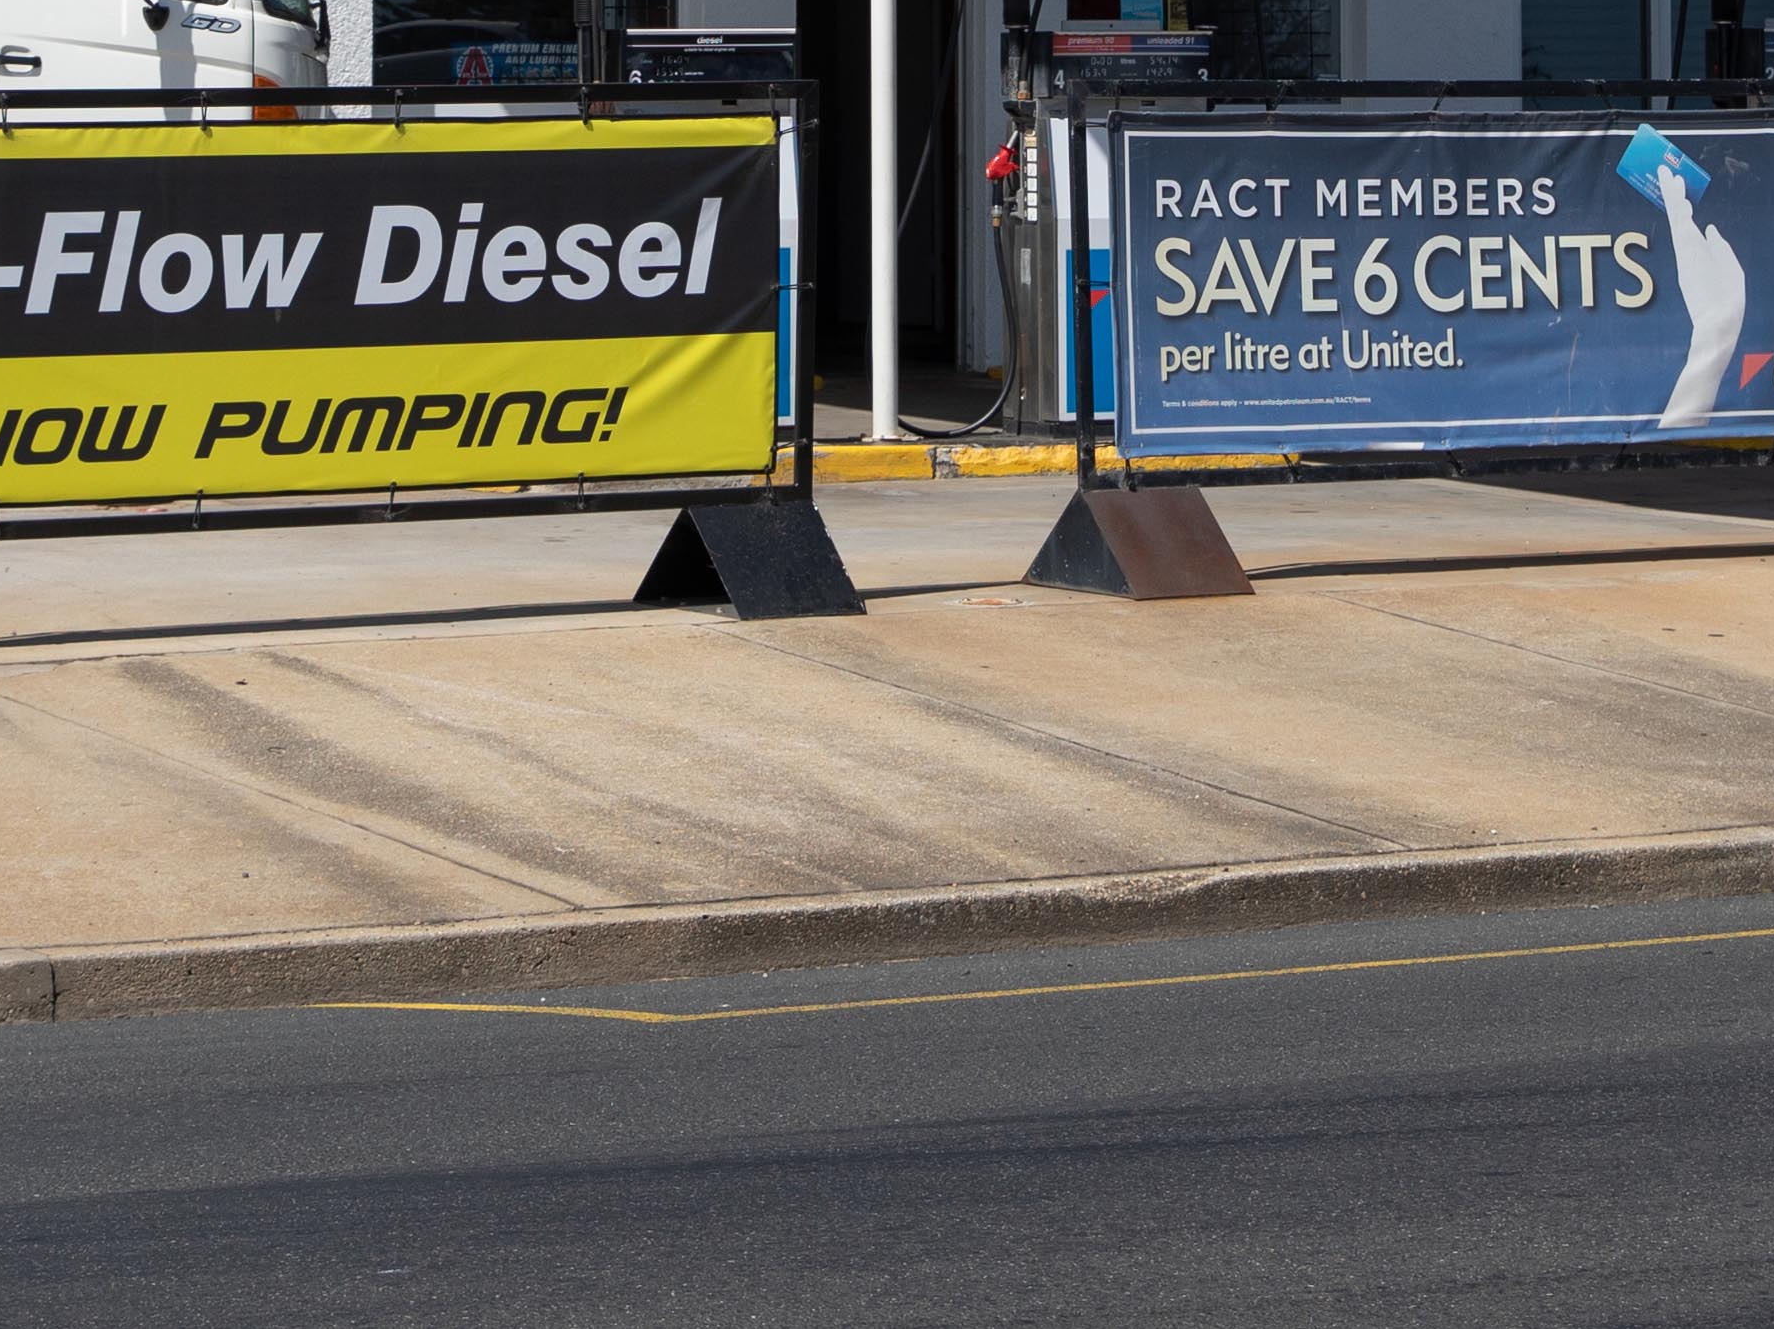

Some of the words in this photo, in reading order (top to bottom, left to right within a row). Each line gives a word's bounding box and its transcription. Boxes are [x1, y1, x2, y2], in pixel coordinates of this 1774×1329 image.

[181, 13, 242, 34] GD
[491, 43, 541, 54] PREMIUM
[542, 43, 579, 54] ENGINE
[696, 35, 723, 45] diesel
[1067, 36, 1103, 46] premium
[1146, 36, 1184, 45] unleaded
[1185, 36, 1195, 45] 91
[504, 55, 528, 64] AND
[629, 70, 642, 84] 6
[1053, 69, 1066, 89] 4
[1156, 179, 1290, 218] RACT
[1317, 177, 1557, 217] MEMBERS
[353, 196, 723, 306] Diesel
[1155, 237, 1338, 317] SAVE
[1353, 235, 1399, 316] 6
[1412, 231, 1655, 312] CENTS
[1159, 340, 1215, 383] per
[1224, 331, 1293, 372] litre
[1298, 335, 1333, 370] at
[1341, 329, 1465, 370] United.
[1162, 399, 1180, 408] Terms
[1187, 398, 1220, 407] conditions
[1220, 398, 1238, 408] apply
[194, 386, 630, 460] PUMPING!
